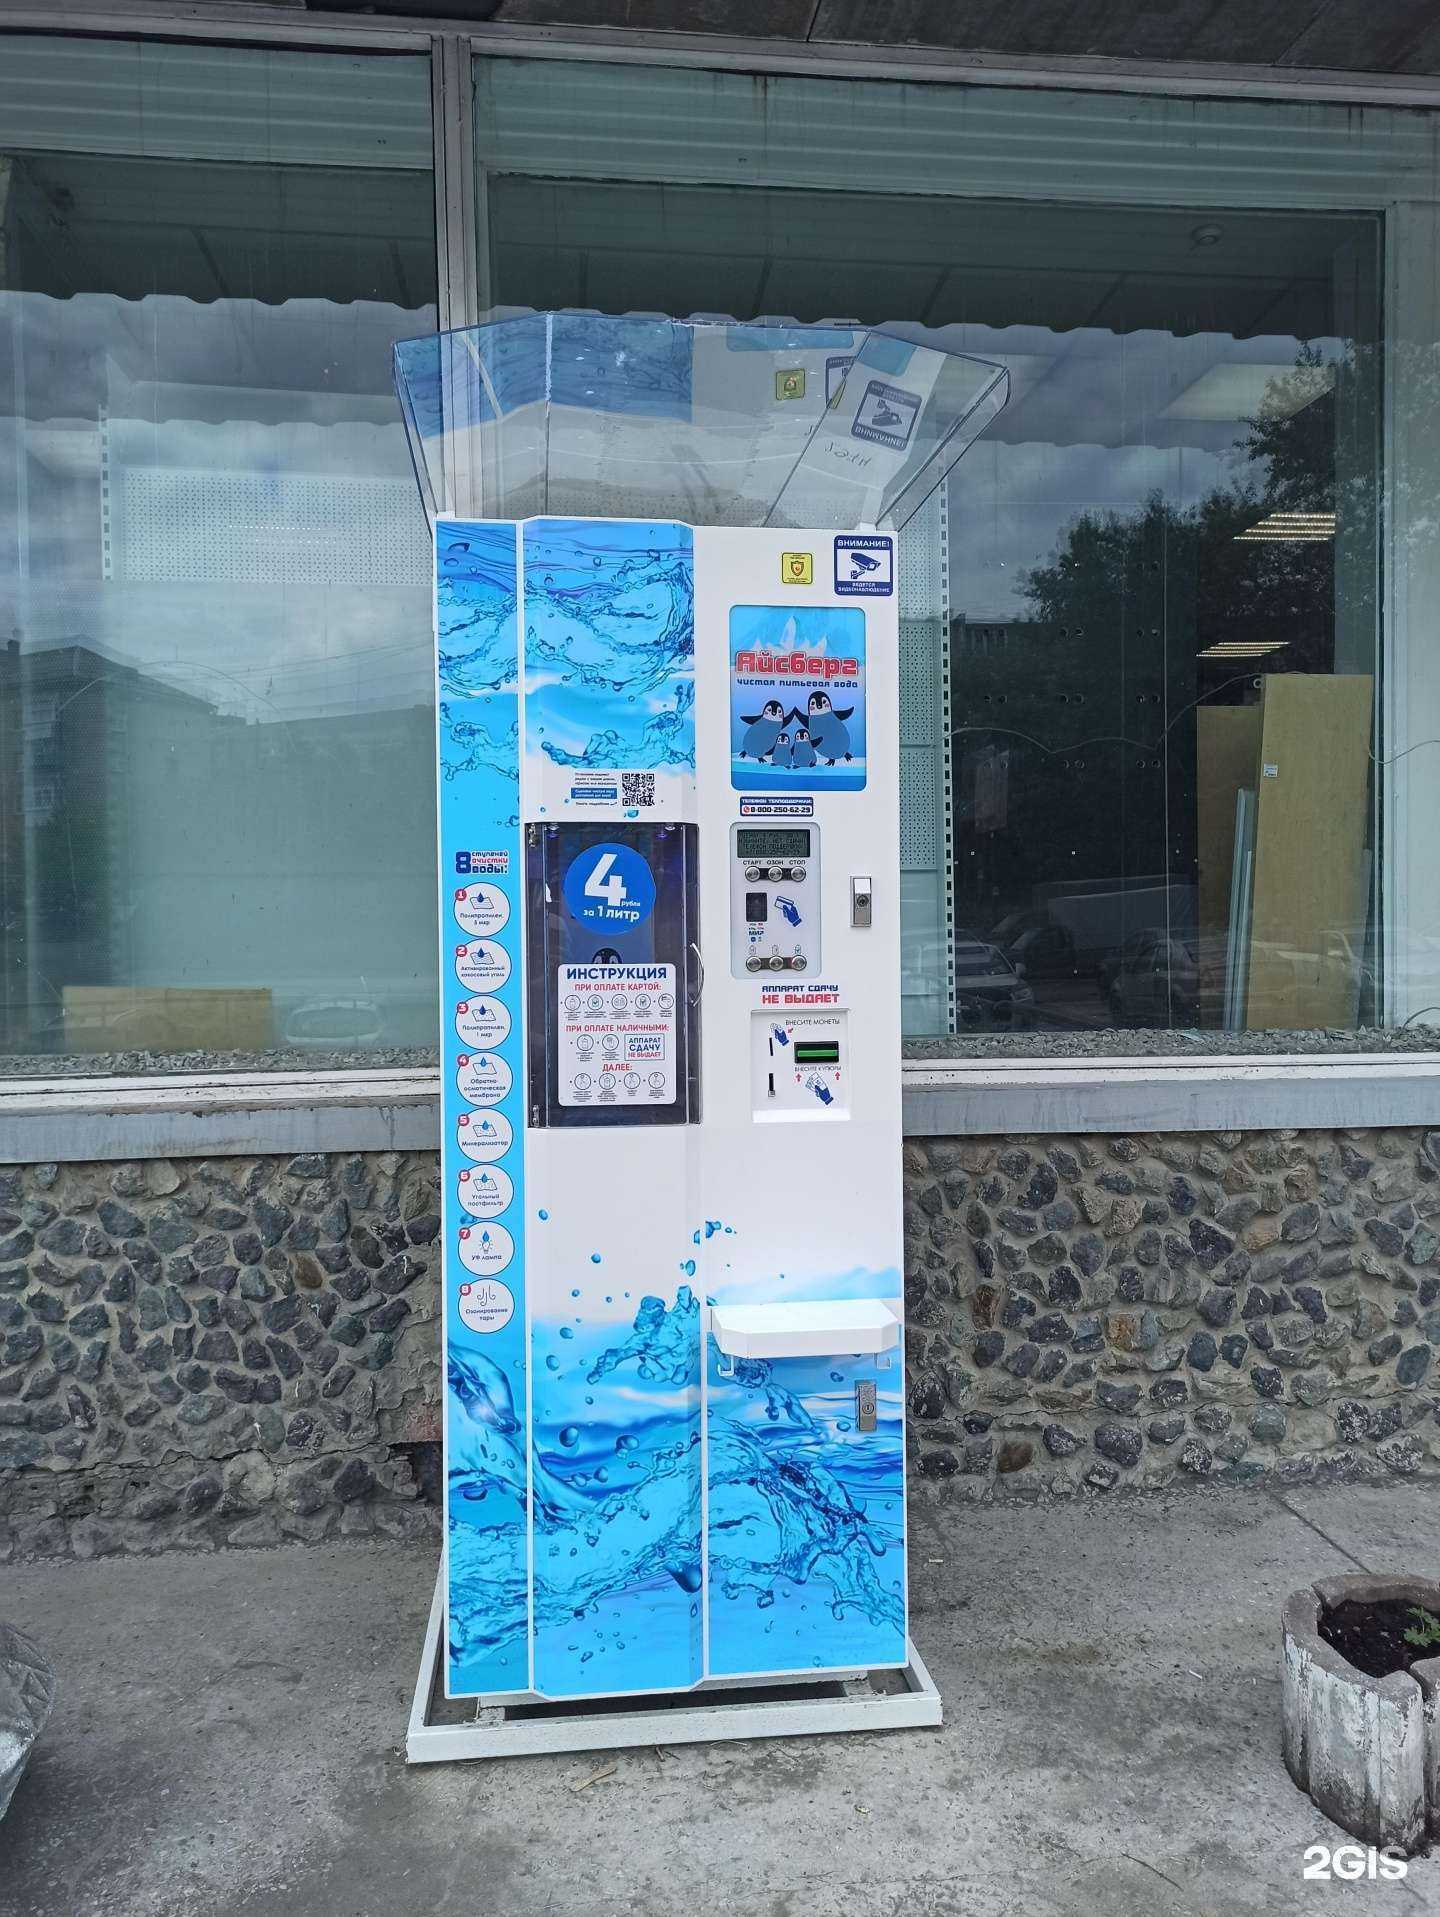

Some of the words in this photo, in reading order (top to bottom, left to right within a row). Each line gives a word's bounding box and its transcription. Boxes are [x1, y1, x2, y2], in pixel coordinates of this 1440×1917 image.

[735, 651, 858, 678] Айсберг
[779, 680, 830, 688] питьевая
[834, 680, 858, 688] вода
[456, 852, 471, 873] 8
[472, 864, 507, 873] воды:
[584, 853, 626, 906] 4
[583, 908, 594, 917] за
[598, 906, 603, 917] 1
[606, 908, 640, 922] литр
[566, 967, 667, 980] ИНСТРУКЦИЯ
[628, 982, 662, 990] КАРТОЙ:
[762, 994, 779, 1004] НЕ
[784, 994, 840, 1004] ВЫДАЕТ
[602, 1064, 633, 1072] ДАЛЕЕ:
[460, 1116, 468, 1124] 5
[462, 1229, 468, 1238] 7
